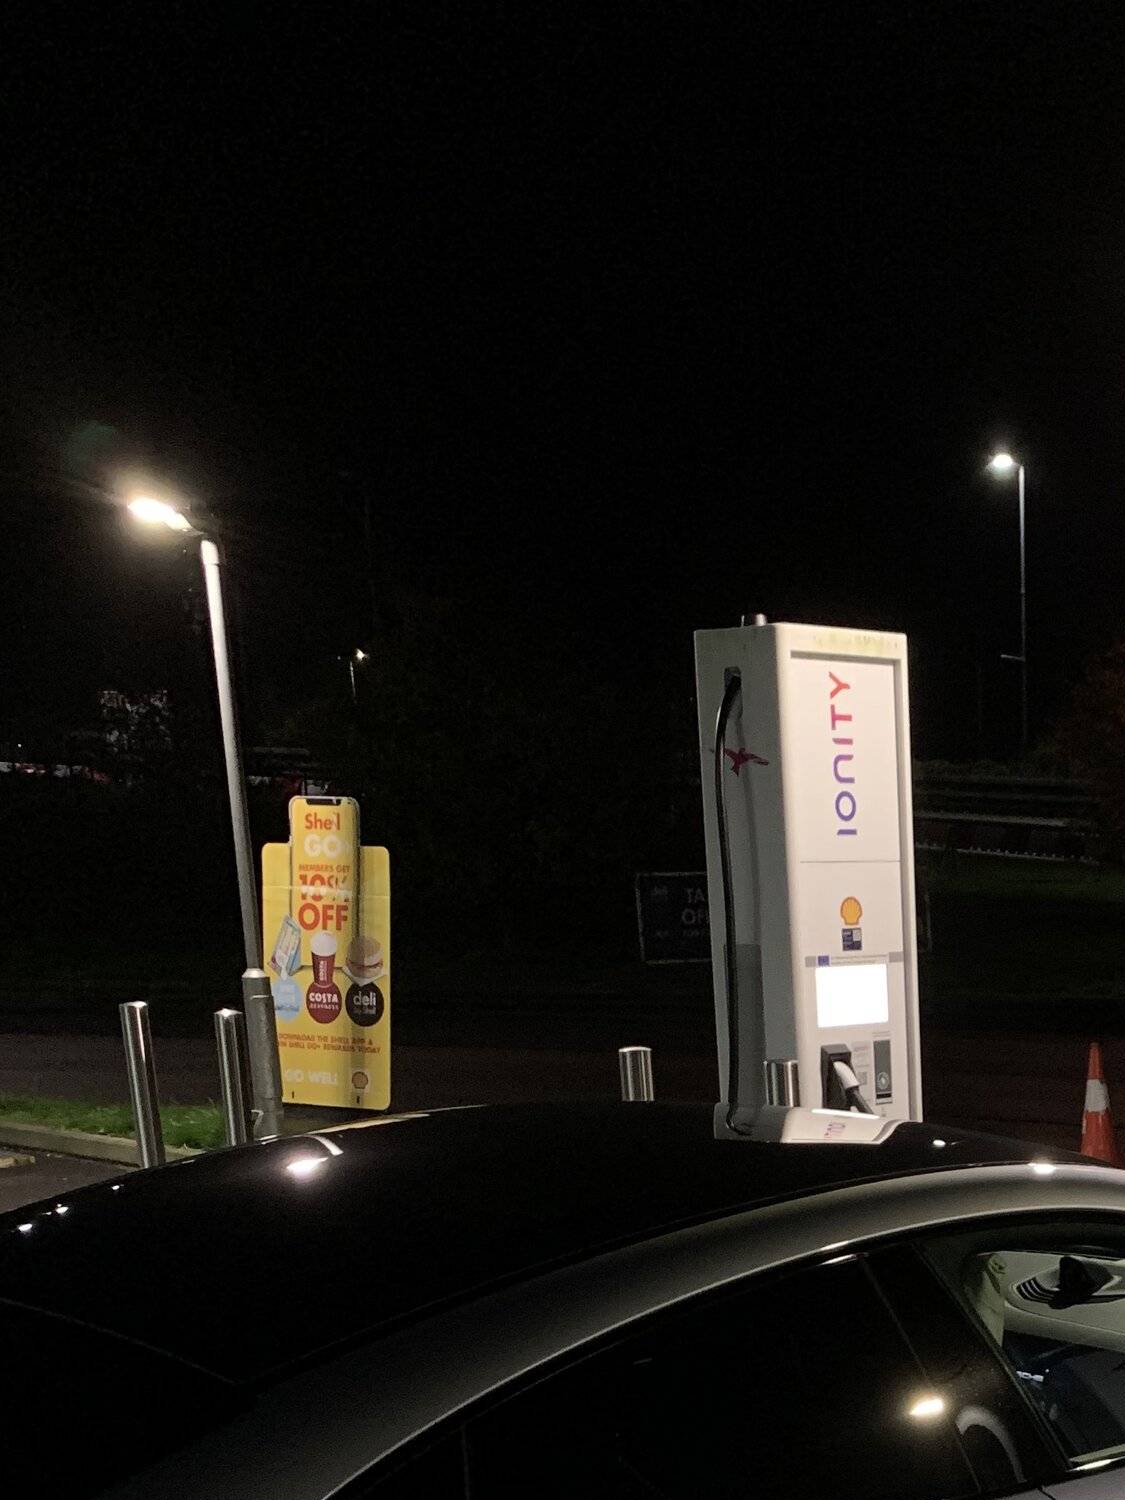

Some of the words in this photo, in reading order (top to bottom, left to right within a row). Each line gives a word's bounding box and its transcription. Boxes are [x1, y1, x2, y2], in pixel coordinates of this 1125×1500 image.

[829, 671, 857, 836] IONITY
[305, 812, 341, 830] Shel
[299, 864, 334, 872] MEMBERS
[336, 865, 351, 873] GET
[299, 903, 348, 930] OFF
[309, 992, 339, 1003] COSTA
[353, 991, 376, 1006] deli
